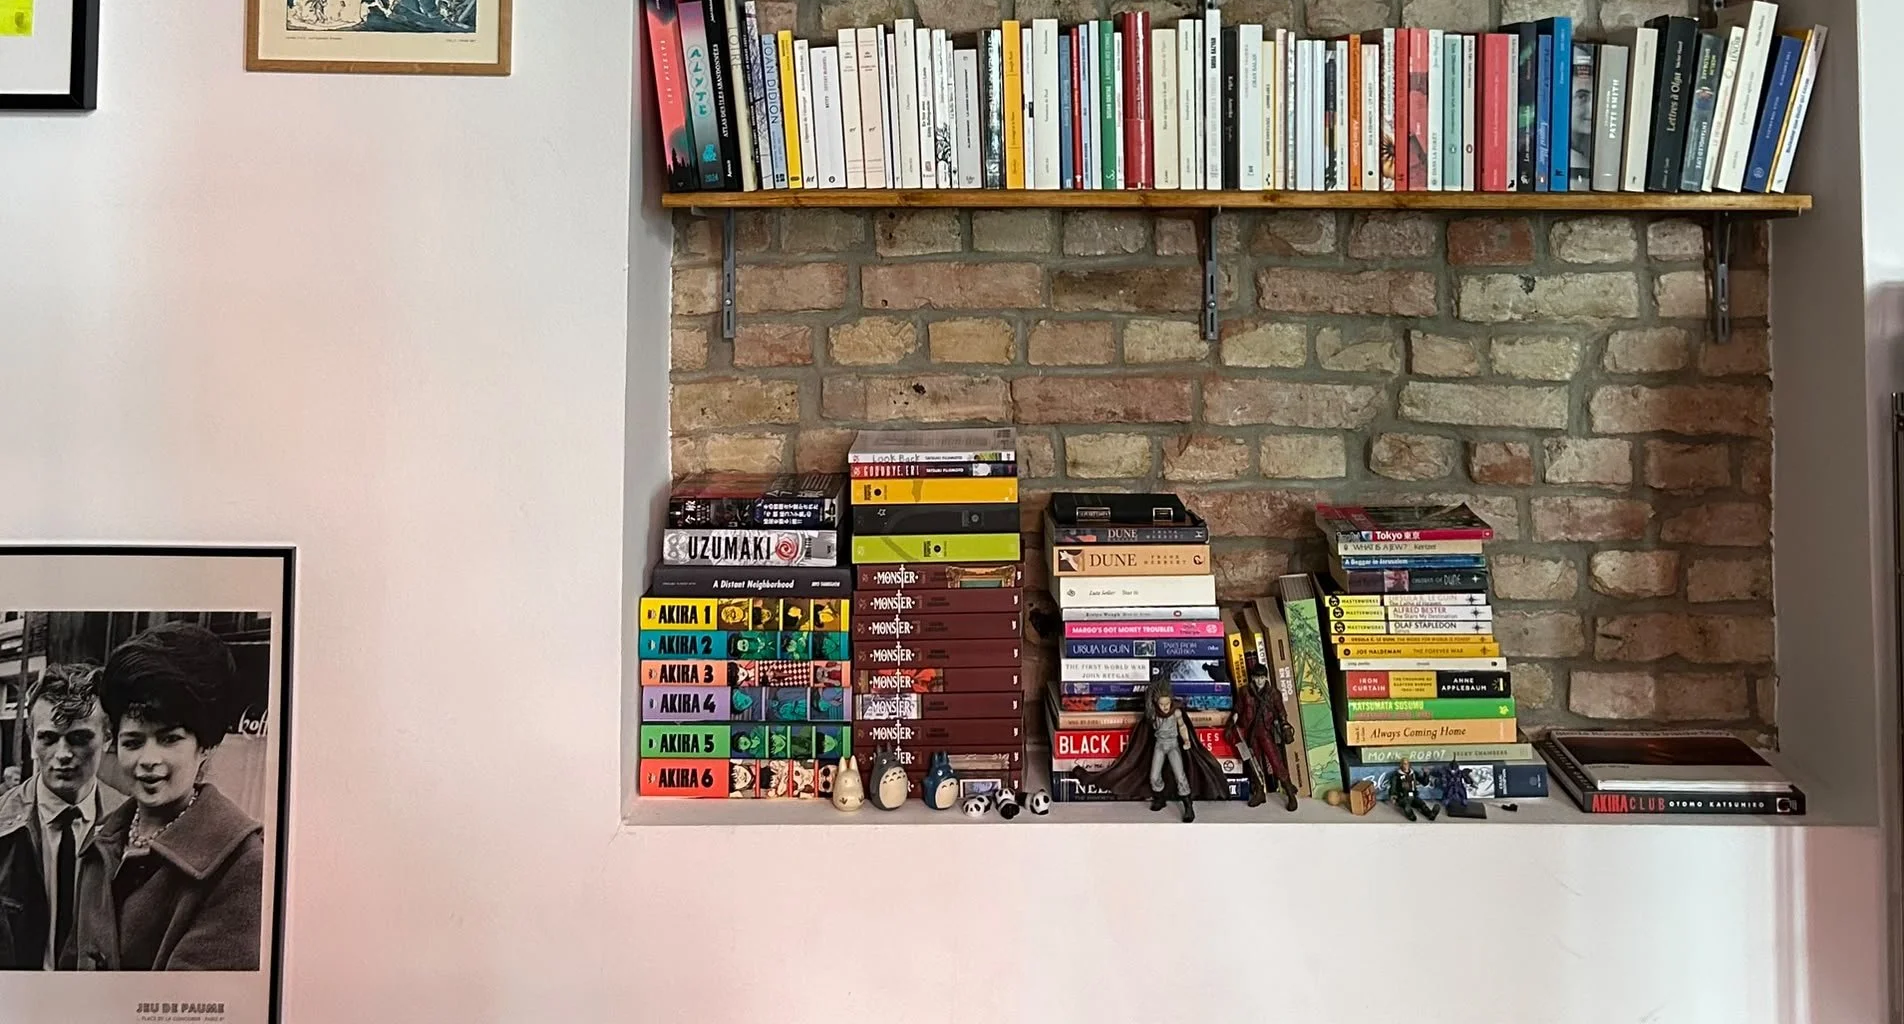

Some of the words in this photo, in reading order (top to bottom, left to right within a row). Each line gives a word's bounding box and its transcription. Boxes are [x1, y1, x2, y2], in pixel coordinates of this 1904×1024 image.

[763, 41, 775, 74] JOAN
[1671, 72, 1682, 93] Olga
[768, 77, 779, 123] DIDION
[1611, 80, 1620, 109] SMITH
[1609, 112, 1617, 138] PATTI
[1666, 102, 1679, 131] Lettres
[1697, 121, 1708, 153] ENTANGLED
[1695, 155, 1703, 169] LIFE
[1107, 529, 1138, 538] DUNE
[1375, 531, 1402, 541] Tokyo
[688, 536, 771, 559] UZUMAKI
[1090, 554, 1137, 567] DUNE
[713, 580, 719, 588] A
[721, 580, 745, 588] Distant
[747, 579, 794, 590] Neighborhood
[876, 568, 916, 586] MONSTER
[873, 593, 913, 611] MONSTER
[659, 604, 698, 624] AKIRA
[703, 605, 711, 624] 1
[871, 618, 911, 636] MONSTER
[658, 635, 699, 654] AKIRA
[701, 635, 713, 654] 2
[872, 645, 912, 663] MONSTER
[659, 665, 700, 684] AKIRA
[703, 665, 713, 683] 3
[872, 672, 912, 690] MONSTER
[660, 694, 700, 713] AKIRA
[703, 693, 716, 712] 4
[872, 723, 912, 742] MONSTER
[1370, 729, 1401, 741] Always
[1403, 728, 1437, 739] Coming
[1440, 727, 1466, 736] Home
[660, 734, 700, 753] AKIRA
[703, 733, 714, 752] 5
[1059, 734, 1110, 754] BLACK
[1410, 750, 1446, 760] ROBOT
[659, 768, 700, 787] AKIRA
[701, 767, 713, 787] 6
[1592, 794, 1628, 812] AKIRA
[1629, 795, 1665, 810] CLUB
[137, 1003, 159, 1013] JEU
[162, 1003, 178, 1013] DE
[181, 1003, 225, 1013] PAUME
